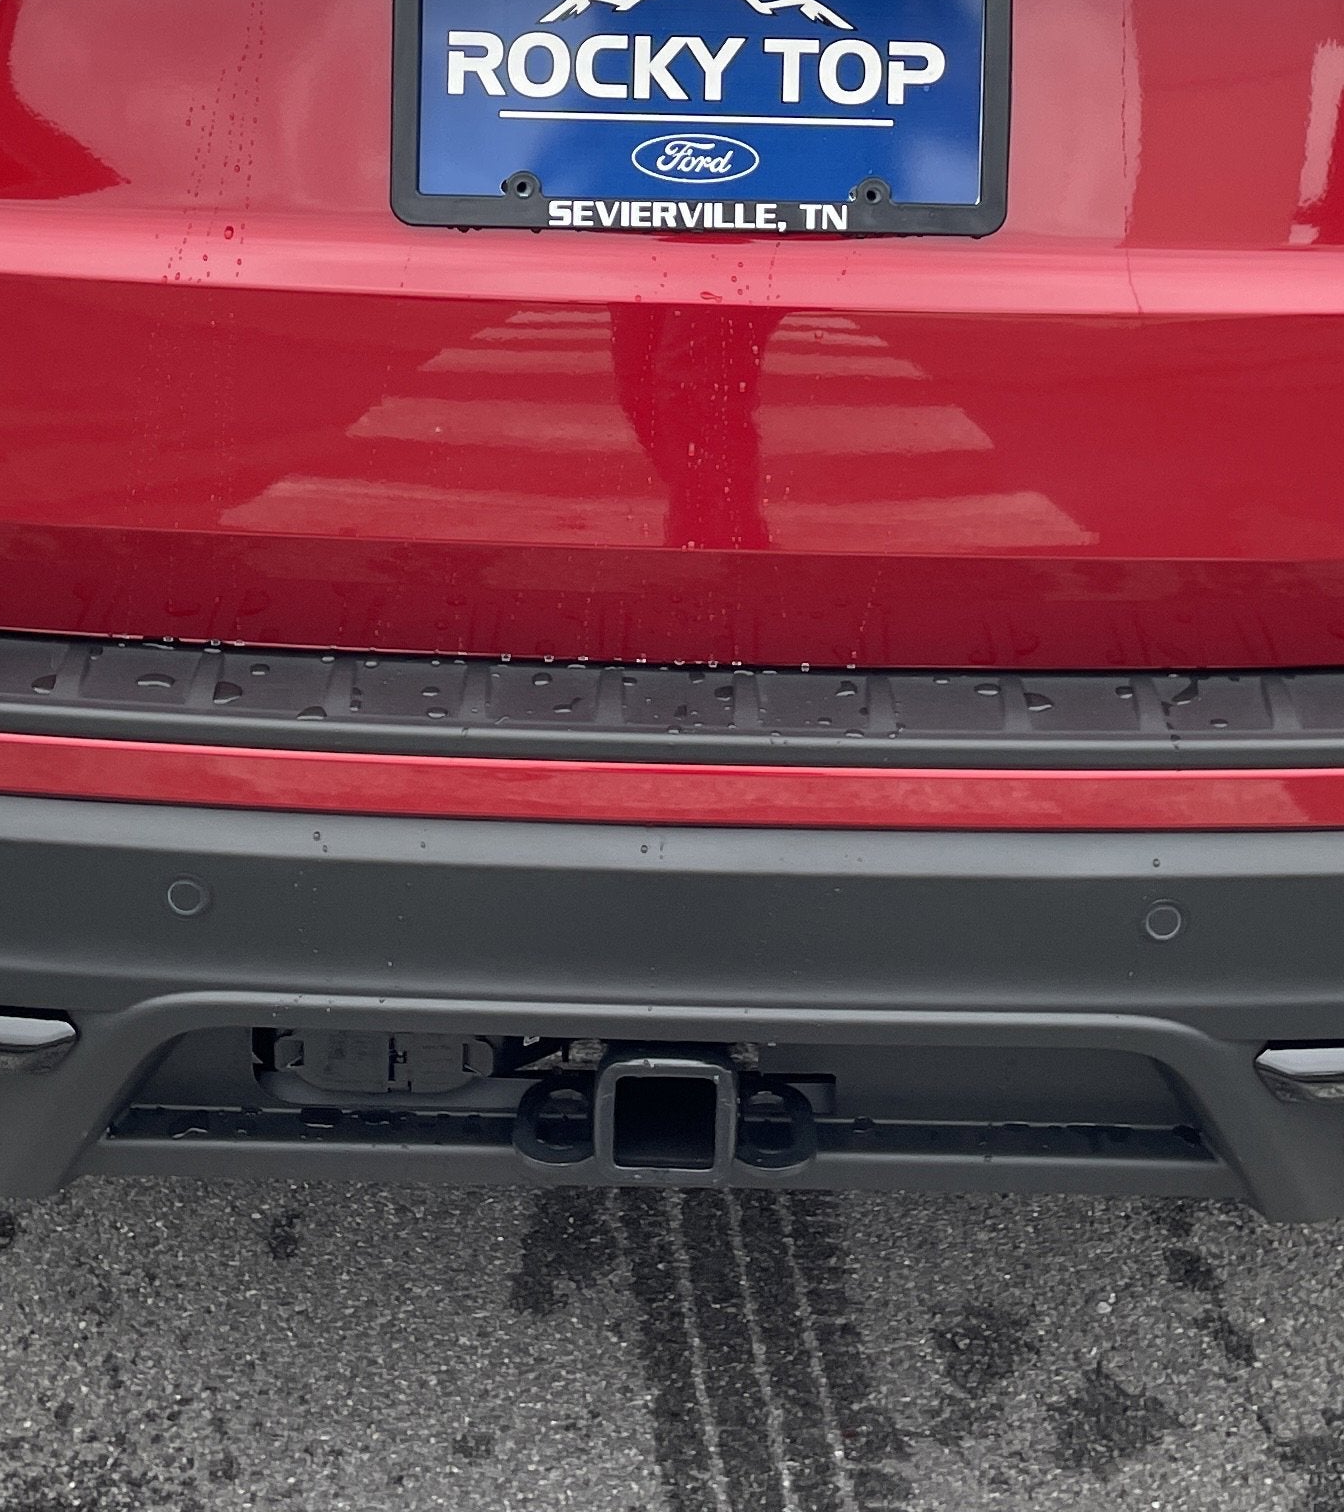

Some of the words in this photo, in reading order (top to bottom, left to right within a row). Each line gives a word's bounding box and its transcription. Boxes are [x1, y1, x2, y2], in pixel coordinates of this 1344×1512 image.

[447, 30, 746, 101] ROCKY
[764, 38, 946, 105] TOP
[656, 140, 734, 174] Ford
[548, 200, 787, 233] SEVIERVILLE,
[798, 203, 848, 231] TN
